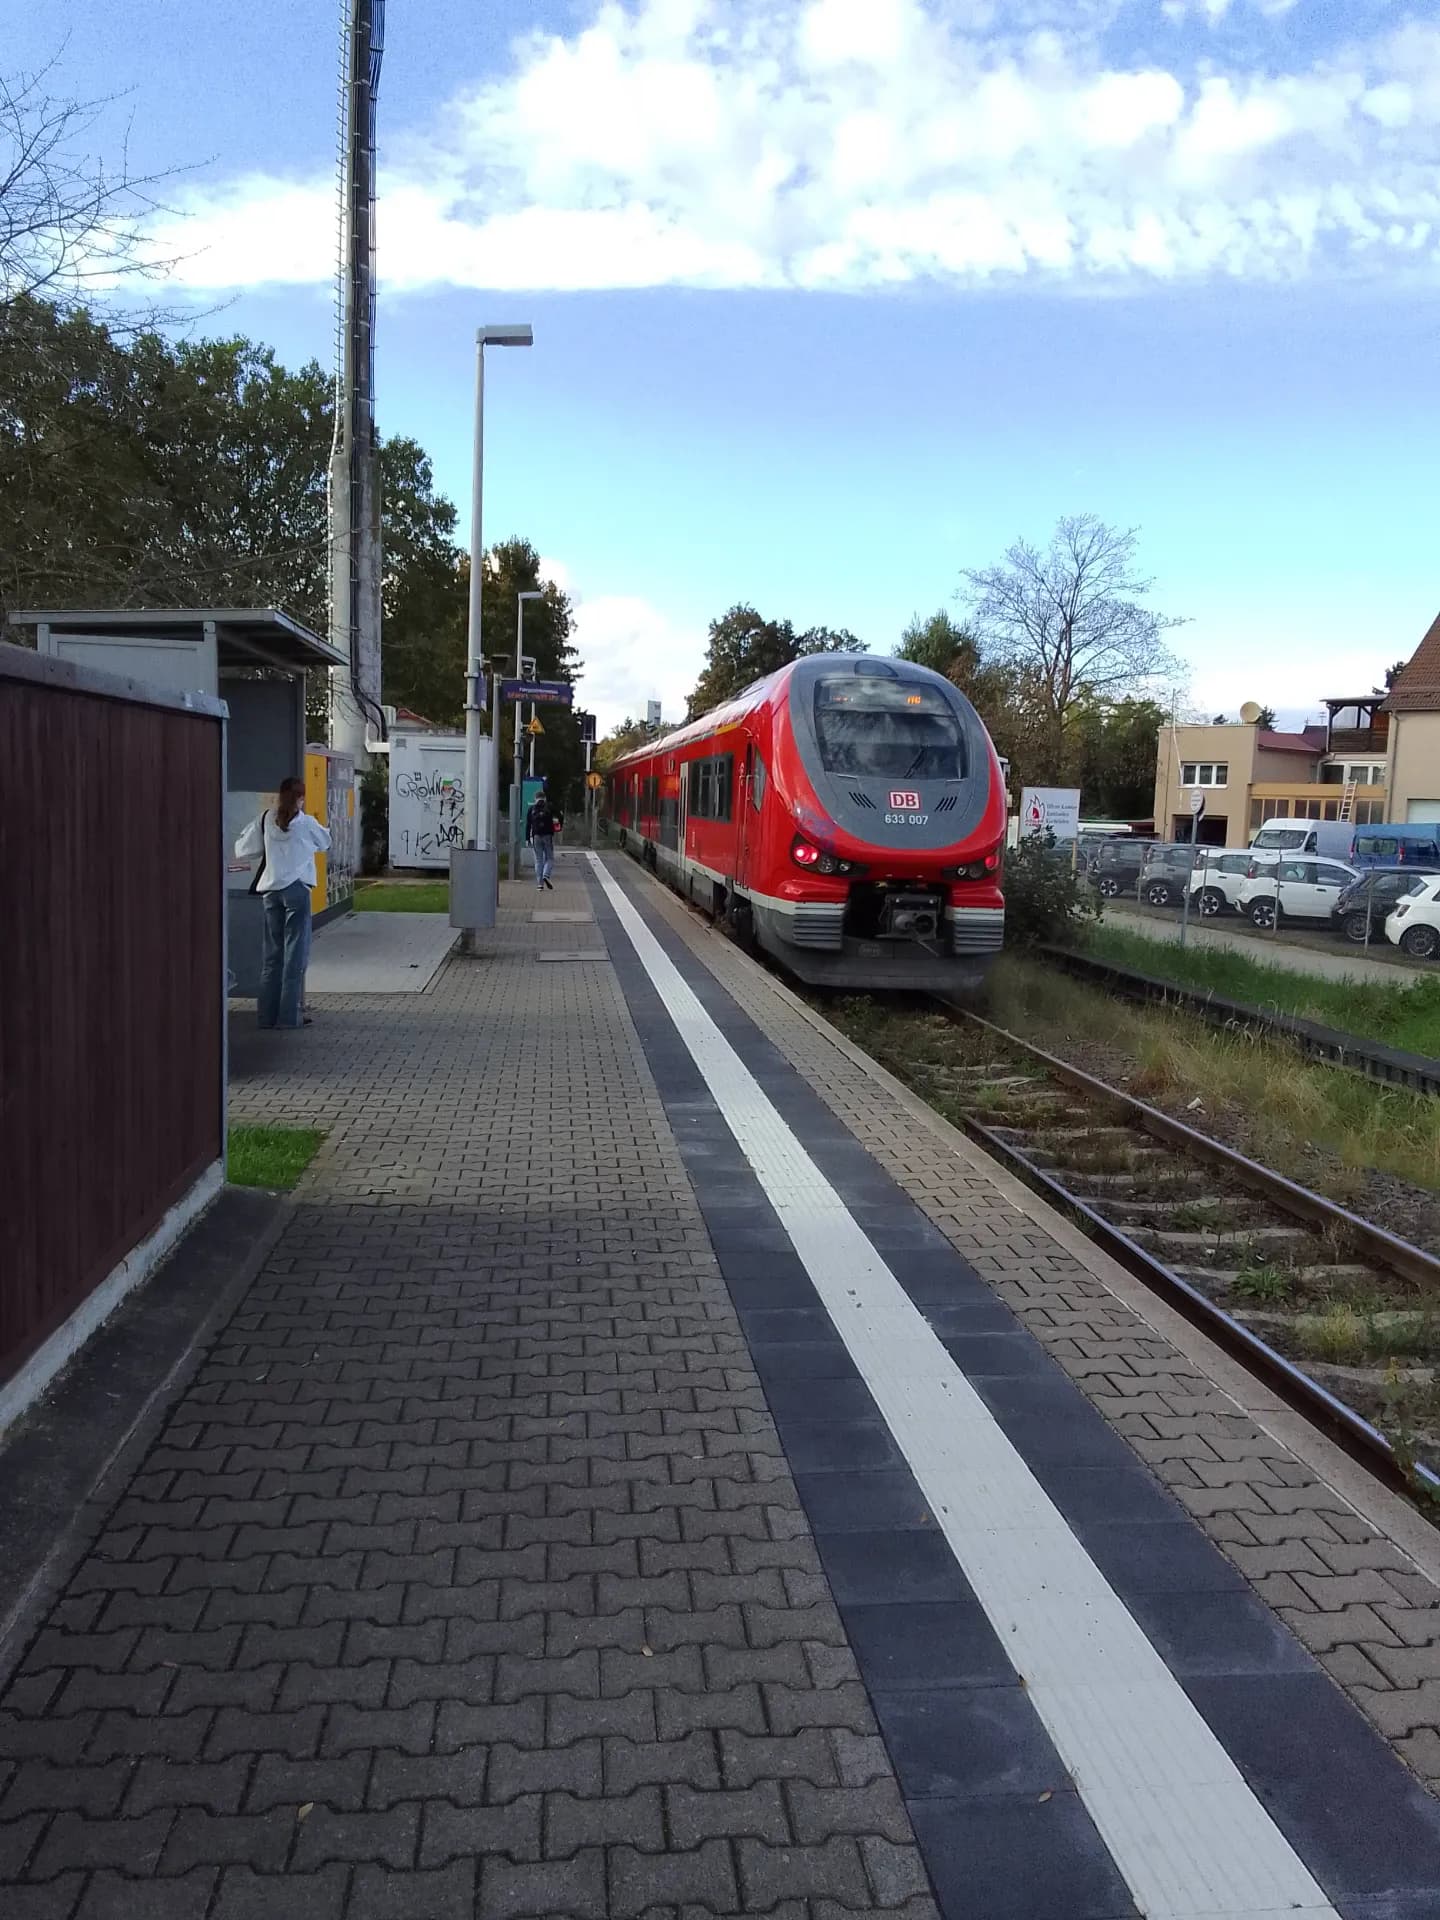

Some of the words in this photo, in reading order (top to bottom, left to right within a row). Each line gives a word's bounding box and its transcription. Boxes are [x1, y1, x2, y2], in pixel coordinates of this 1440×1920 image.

[892, 793, 917, 807] DB
[884, 814, 905, 824] 633
[908, 815, 929, 825] 007
